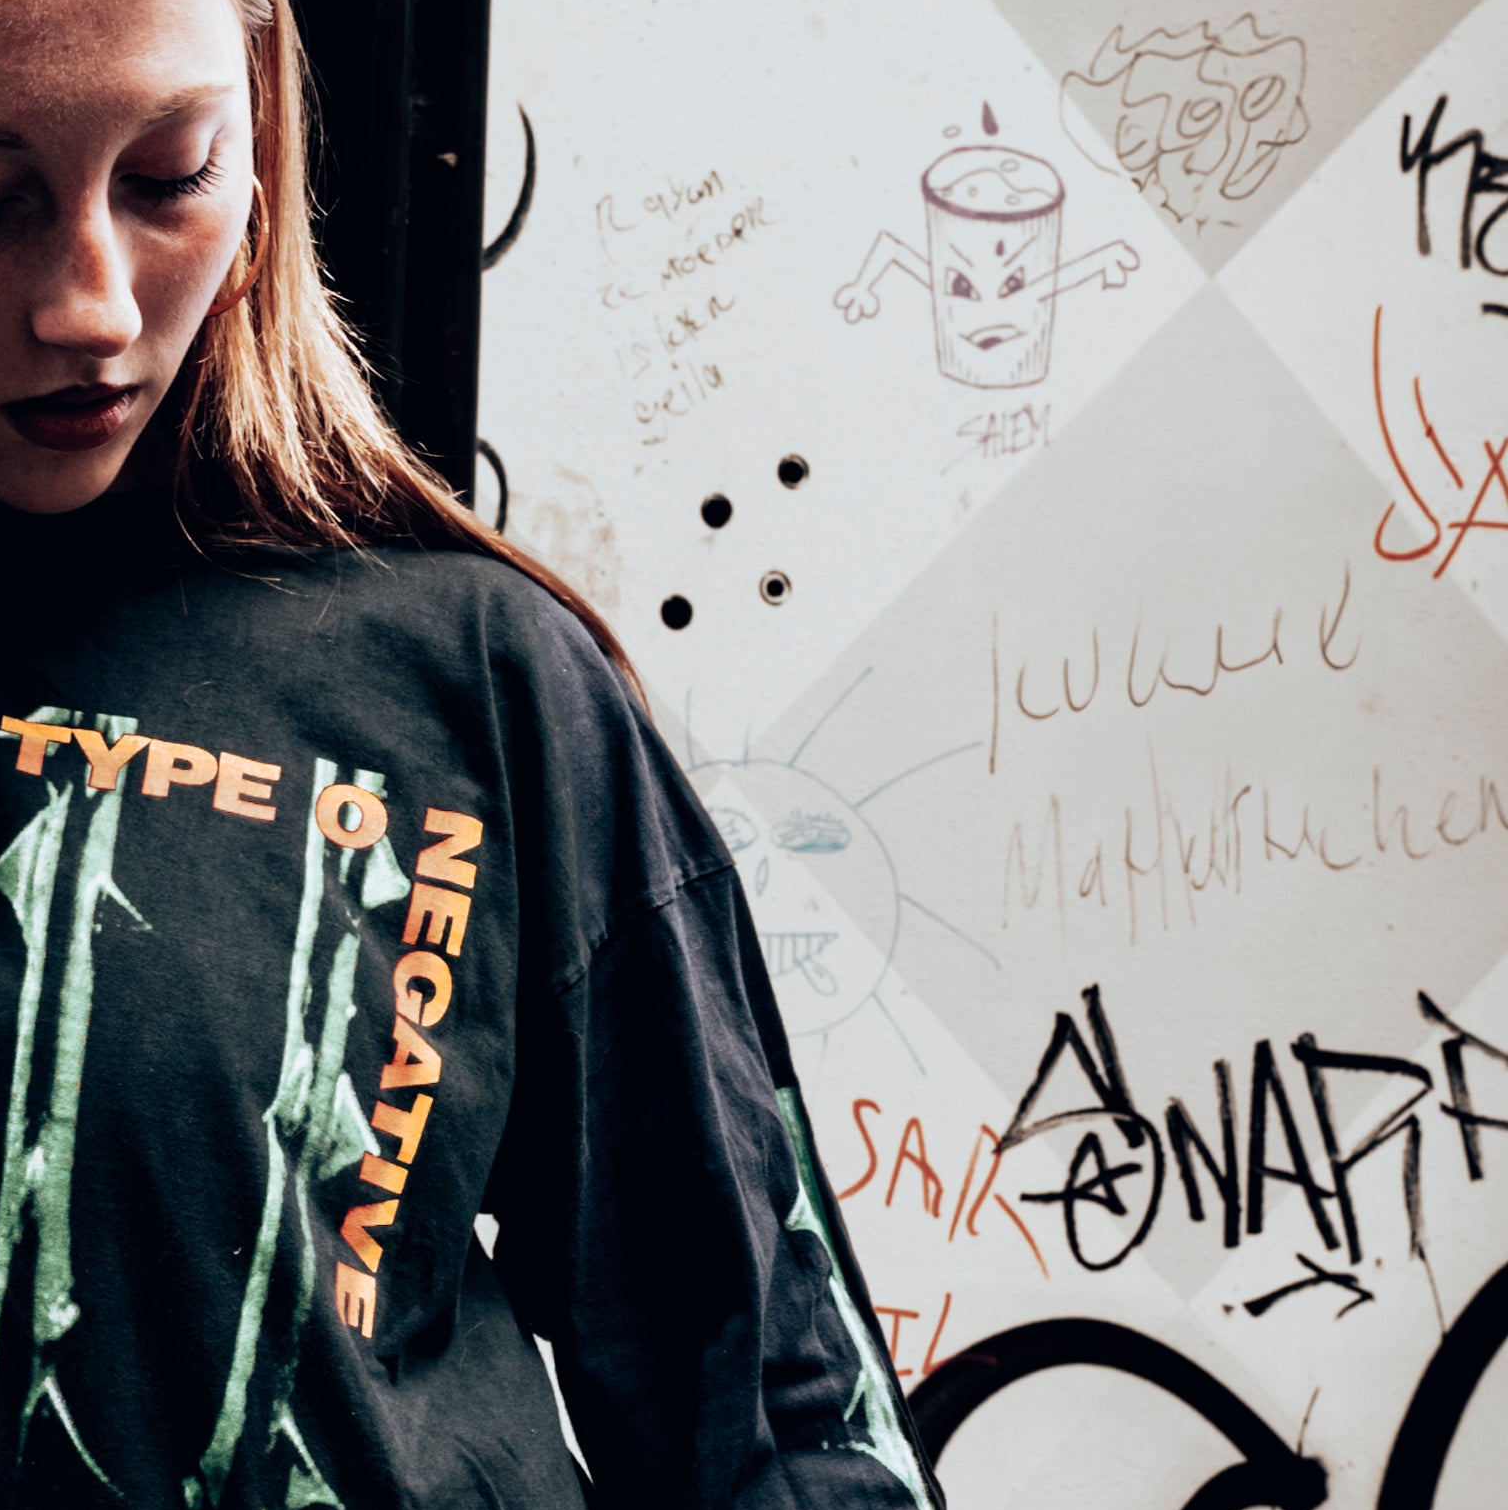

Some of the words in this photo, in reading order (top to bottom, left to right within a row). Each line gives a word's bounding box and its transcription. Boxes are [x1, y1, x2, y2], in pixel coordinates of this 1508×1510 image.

[1, 714, 282, 823] TYPE
[315, 782, 389, 850] O
[334, 806, 484, 1340] NEGATIVE
